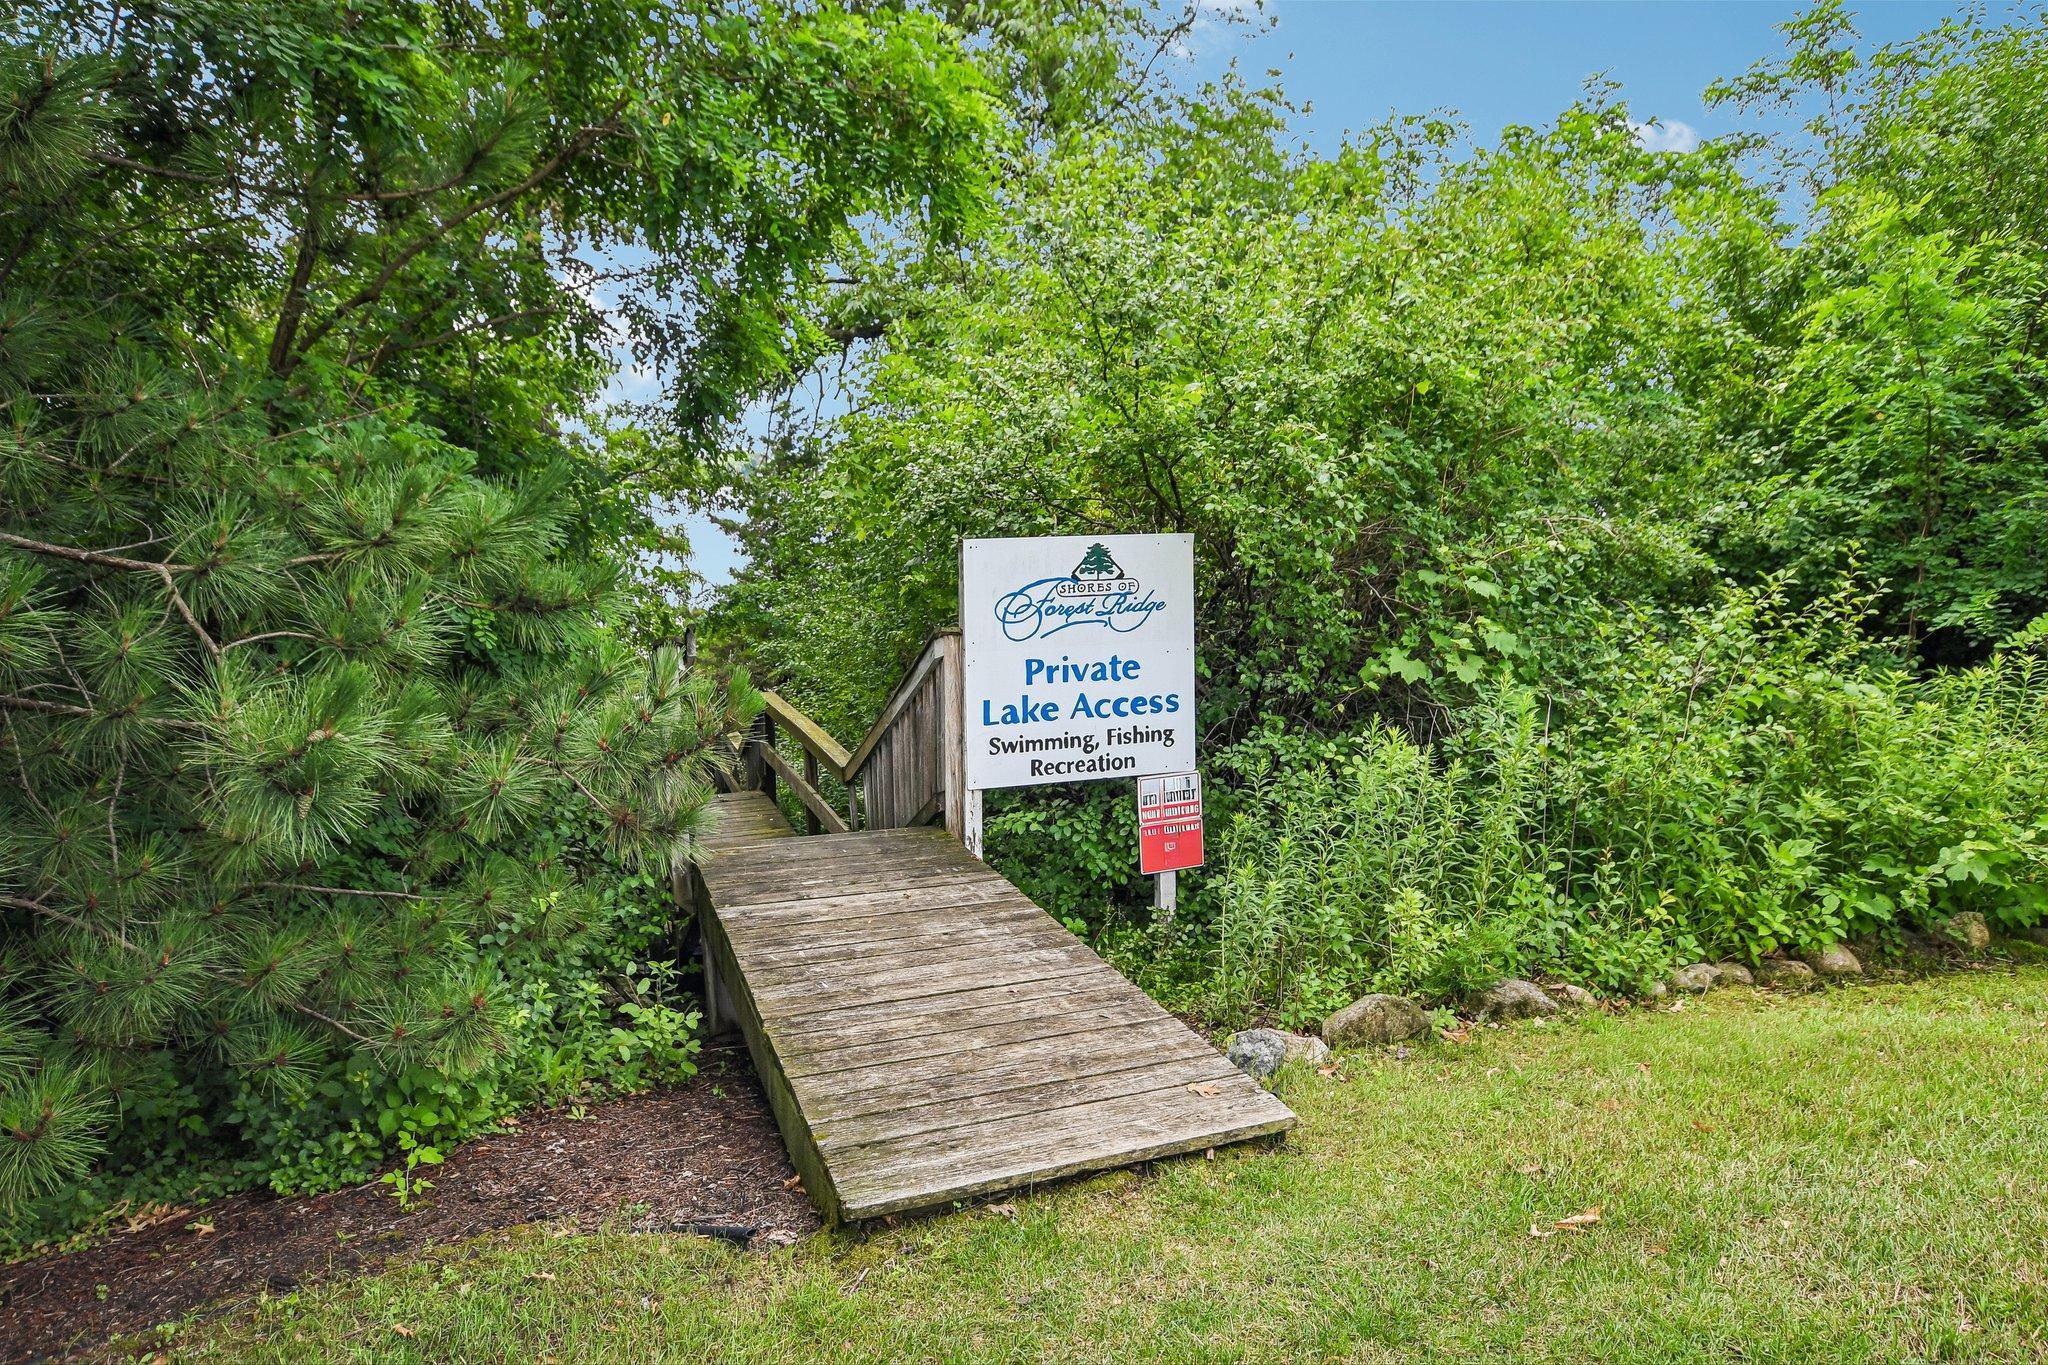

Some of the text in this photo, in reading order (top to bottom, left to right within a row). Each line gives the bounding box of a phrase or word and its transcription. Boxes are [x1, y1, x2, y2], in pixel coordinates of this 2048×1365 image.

[1059, 581, 1136, 594] SHORES OF
[1095, 590, 1167, 632] Ridge
[1025, 655, 1141, 686] Private
[982, 692, 1180, 726] Lake Access
[989, 725, 1175, 755] Swimming, Fishing
[1030, 752, 1136, 777] Recreation
